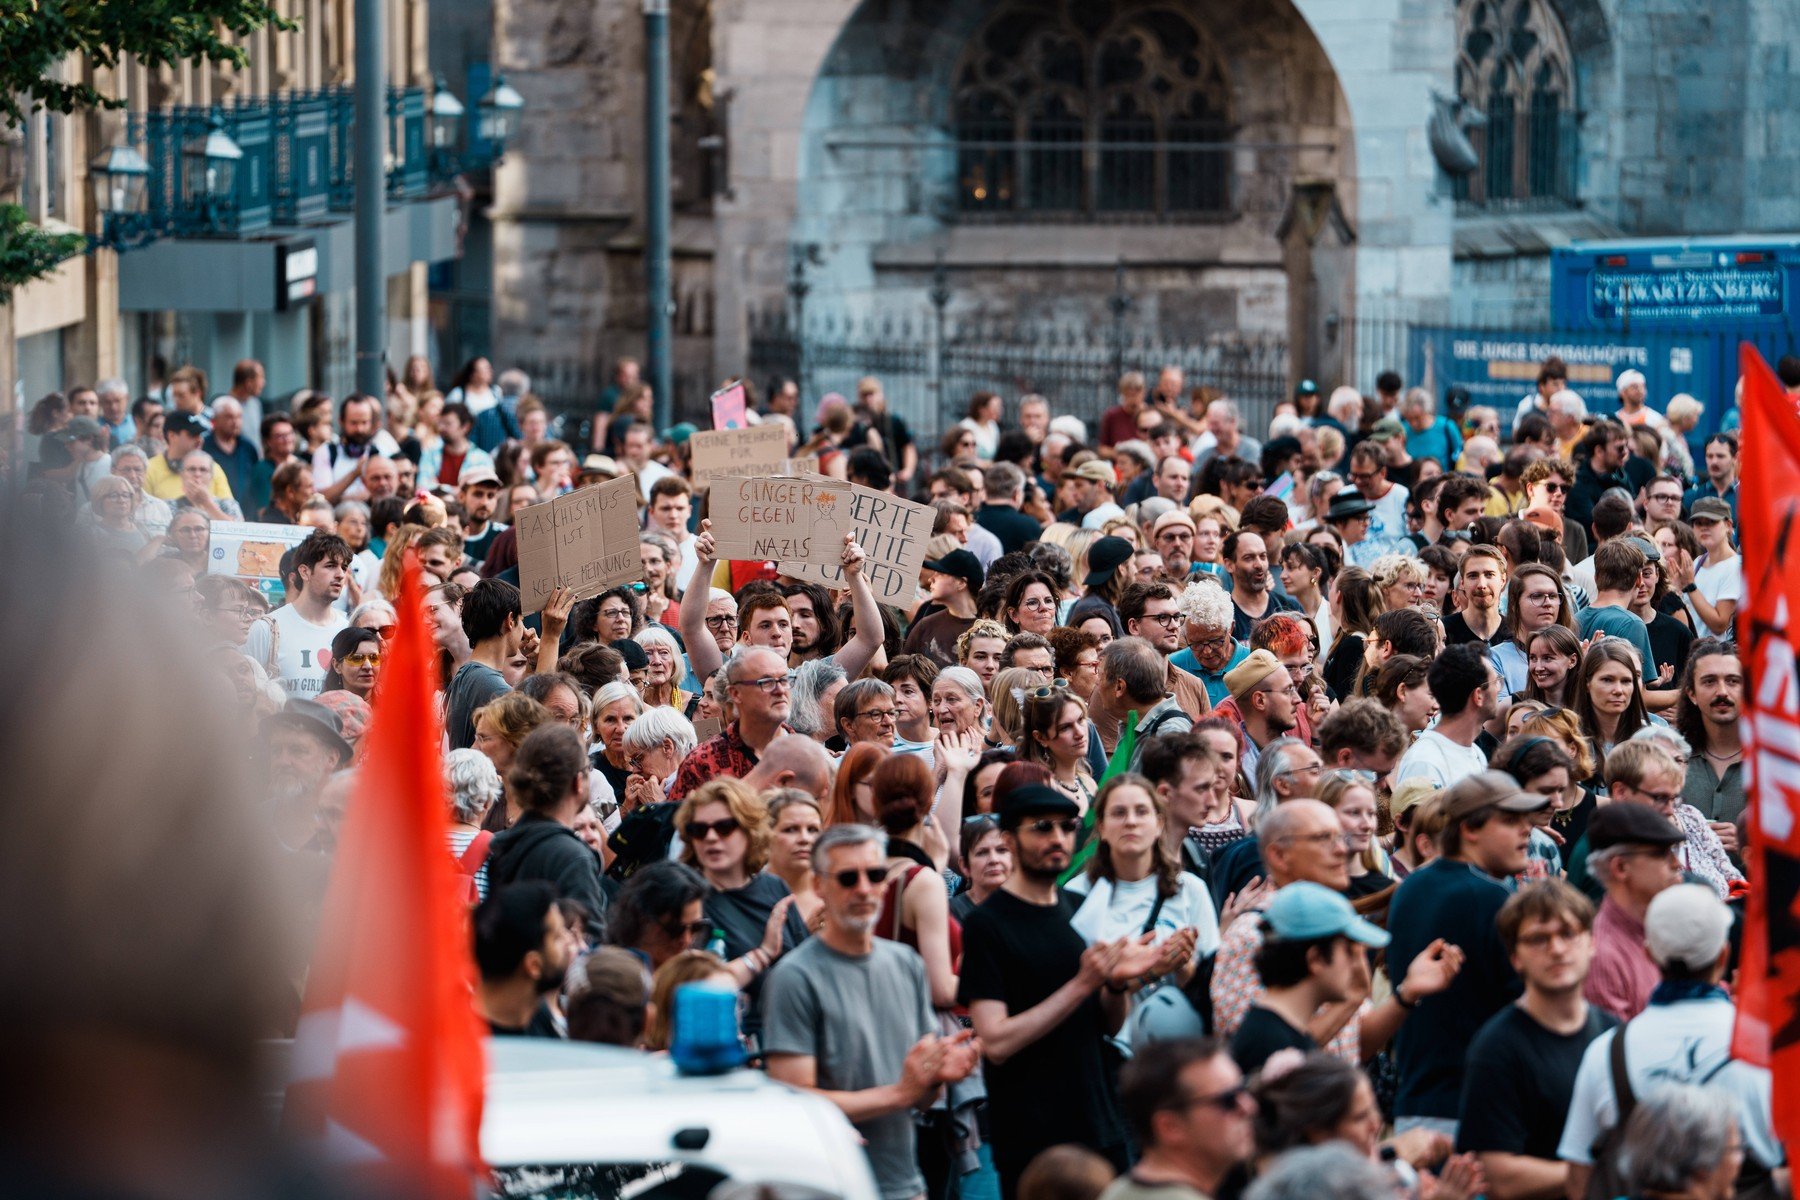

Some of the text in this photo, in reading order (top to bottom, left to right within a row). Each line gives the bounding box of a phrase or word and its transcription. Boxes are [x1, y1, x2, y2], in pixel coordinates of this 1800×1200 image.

[1453, 340, 1480, 360] DIE
[1482, 340, 1527, 361] JUNGE
[695, 433, 731, 449] KEINE
[730, 446, 753, 459] FÜR
[740, 480, 814, 505] GINGER
[520, 489, 620, 541] FASCHISMUS
[738, 505, 796, 524] GEGEN
[563, 525, 584, 546] IST
[753, 537, 812, 558] NAZIS
[532, 550, 631, 598] KEINE MEINUNG
[300, 649, 312, 668] I
[286, 678, 299, 692] MY
